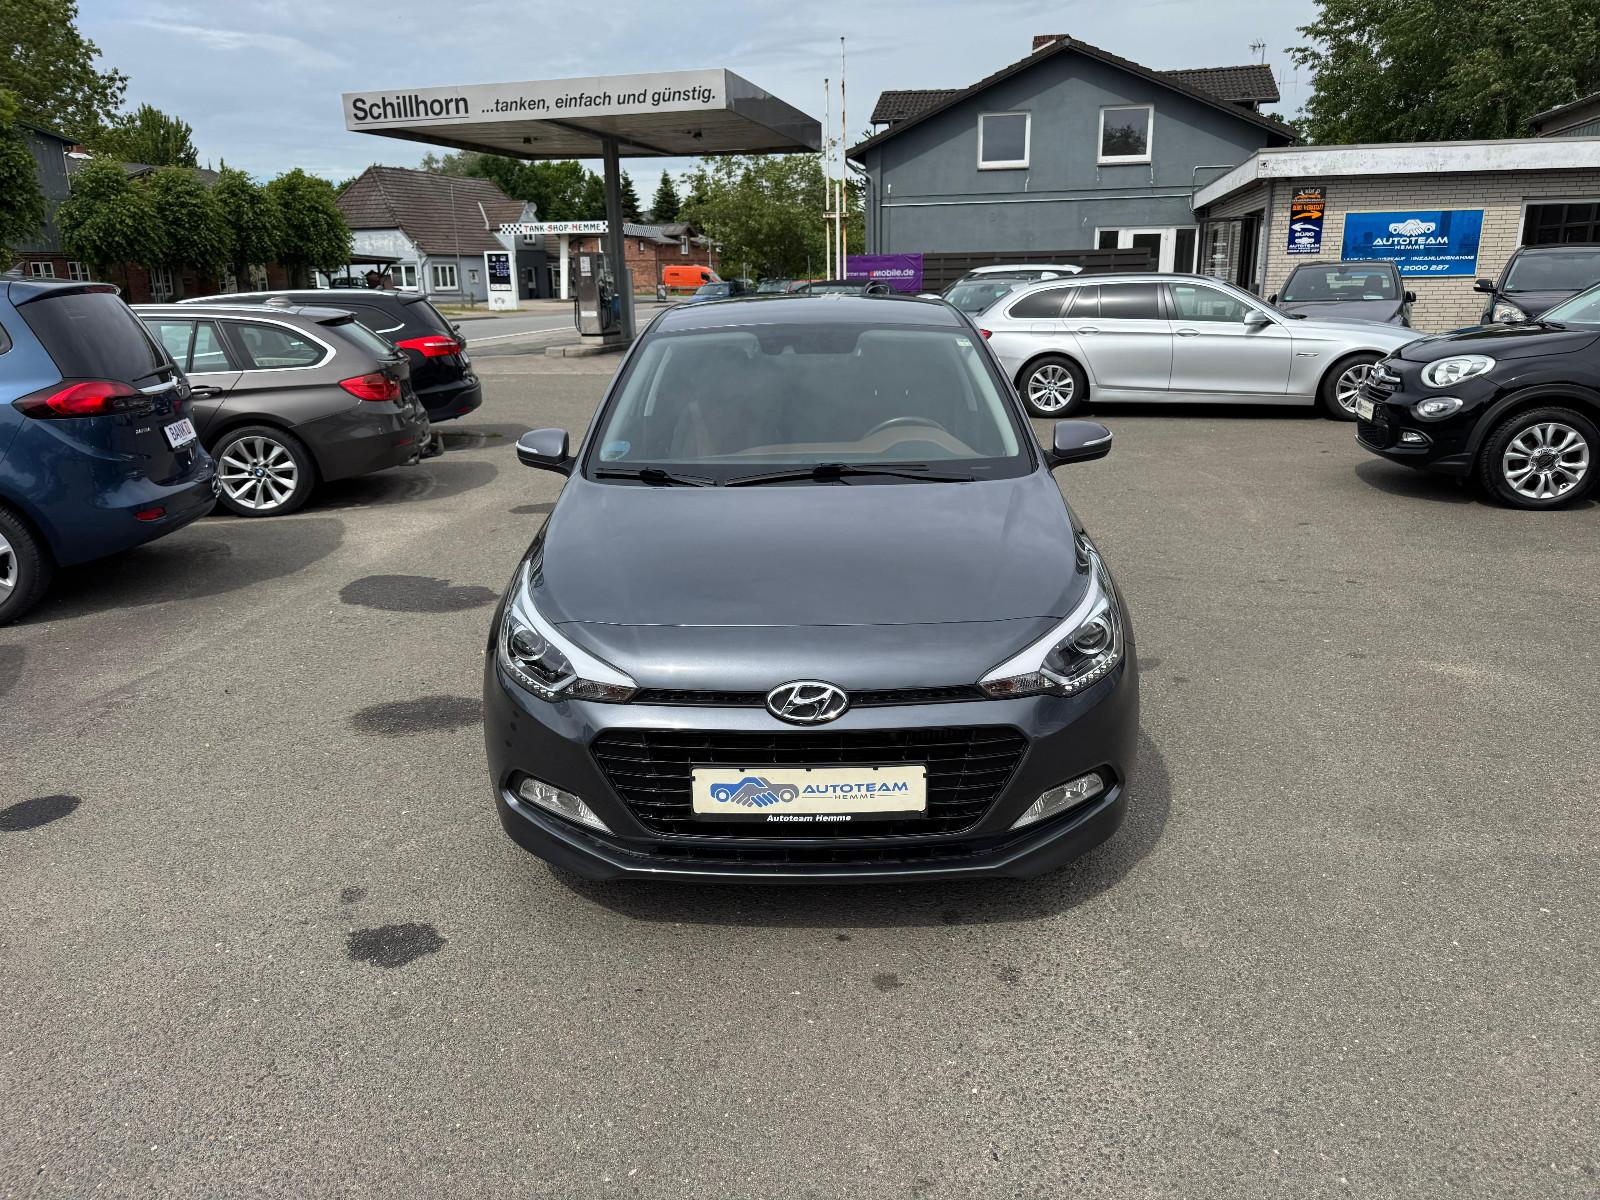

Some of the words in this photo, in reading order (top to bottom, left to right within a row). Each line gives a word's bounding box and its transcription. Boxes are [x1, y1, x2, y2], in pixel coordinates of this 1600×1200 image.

[352, 94, 469, 121] Schillhorn
[481, 96, 550, 113] ...tanken,
[555, 91, 612, 109] einfach
[617, 89, 647, 105] und
[651, 85, 716, 106] günstig.
[1372, 236, 1449, 246] AUTOTEAM
[873, 268, 915, 277] mobile.de
[801, 781, 909, 794] AUTOTEAM
[766, 814, 813, 822] Autoteam
[815, 813, 852, 822] Hemme
